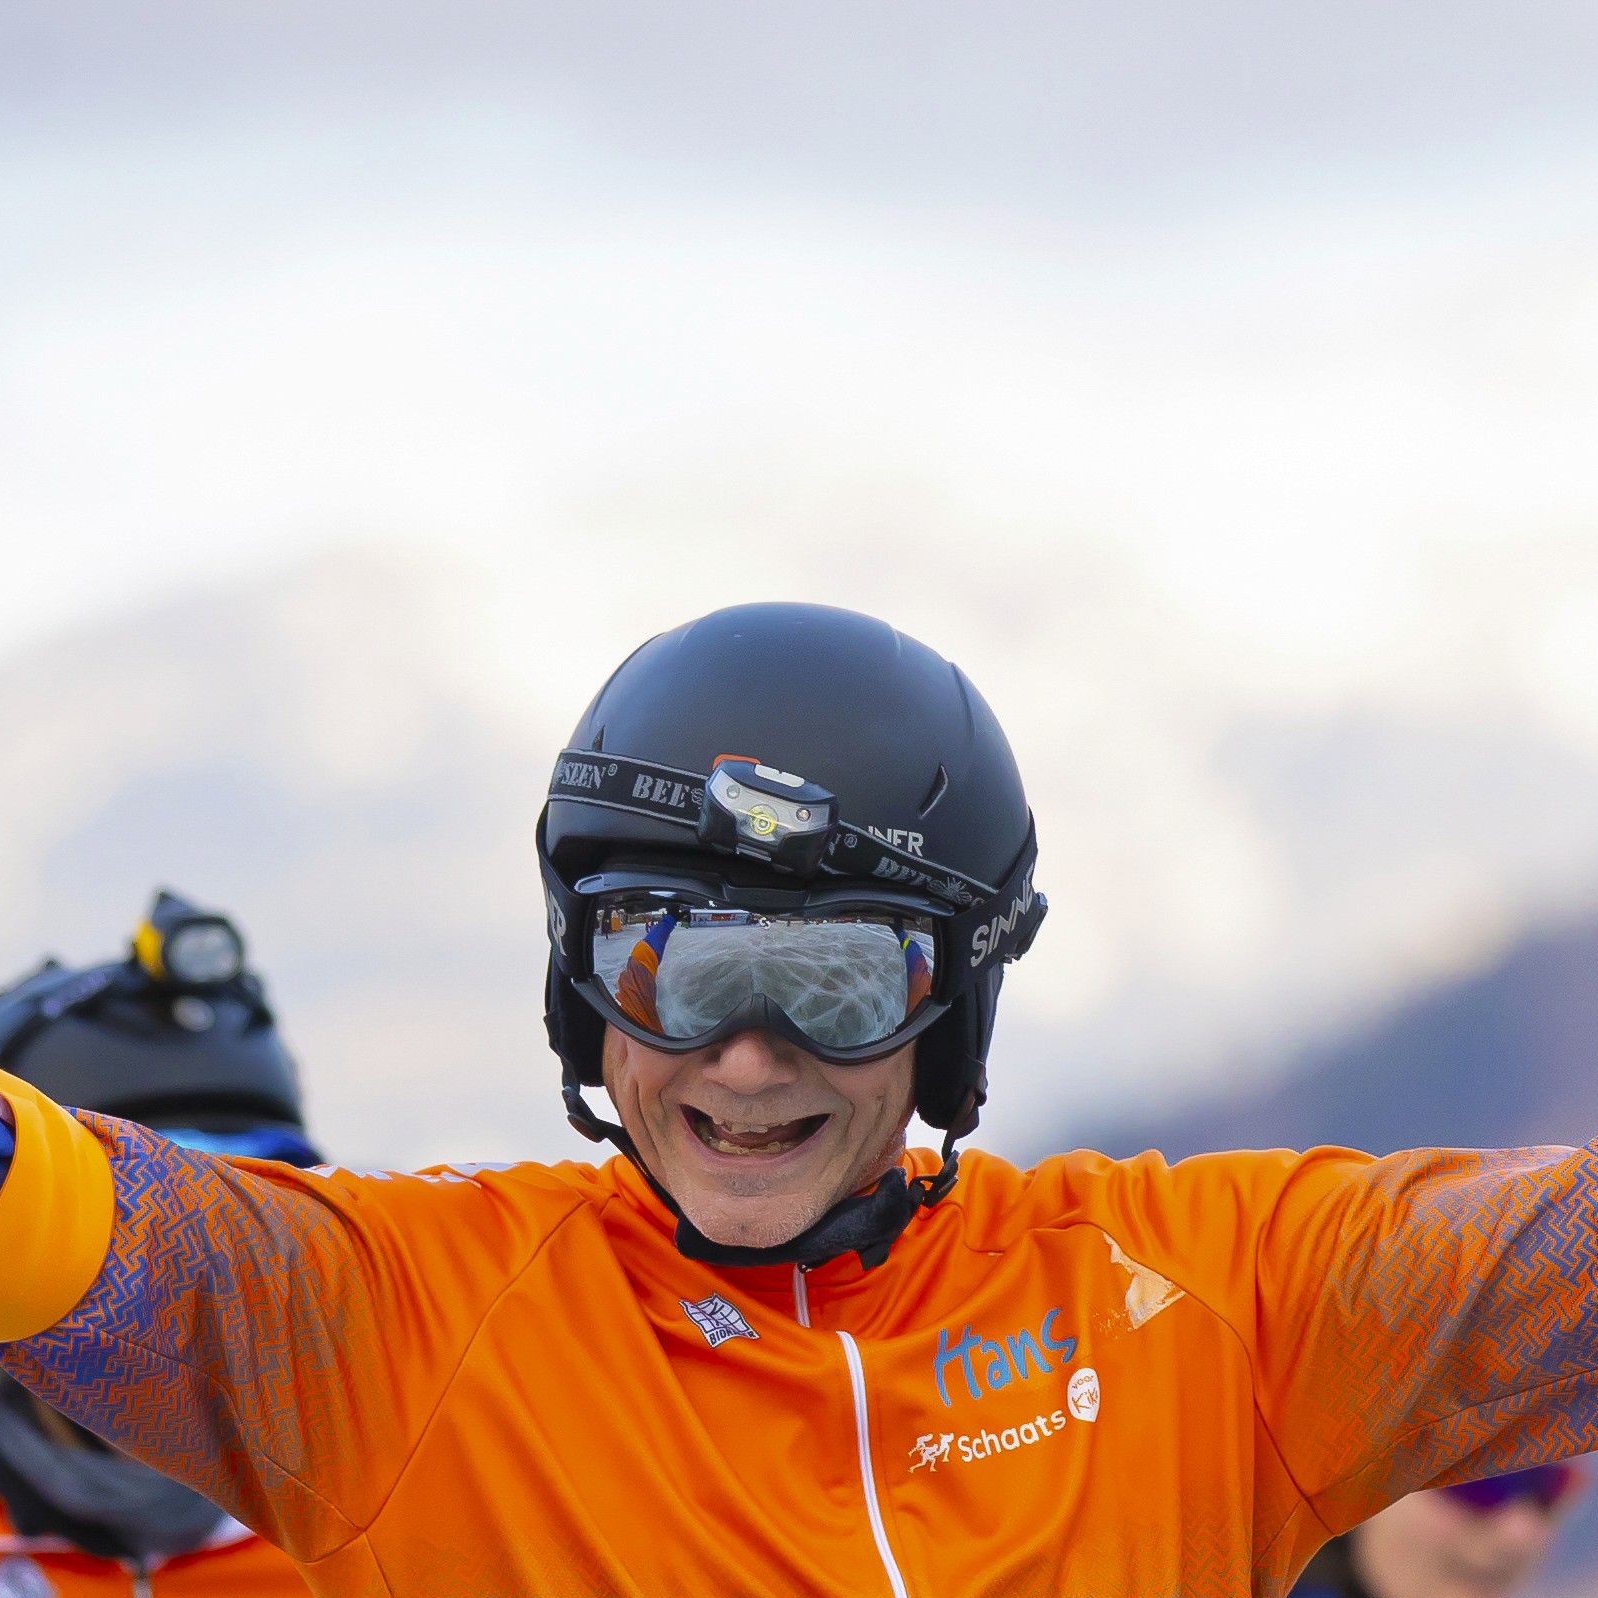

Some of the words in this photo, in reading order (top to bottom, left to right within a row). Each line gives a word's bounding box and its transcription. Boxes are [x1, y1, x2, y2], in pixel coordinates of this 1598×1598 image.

[632, 773, 690, 808] BEE
[933, 1307, 1078, 1407] Hans
[957, 1409, 1067, 1463] Schaats
